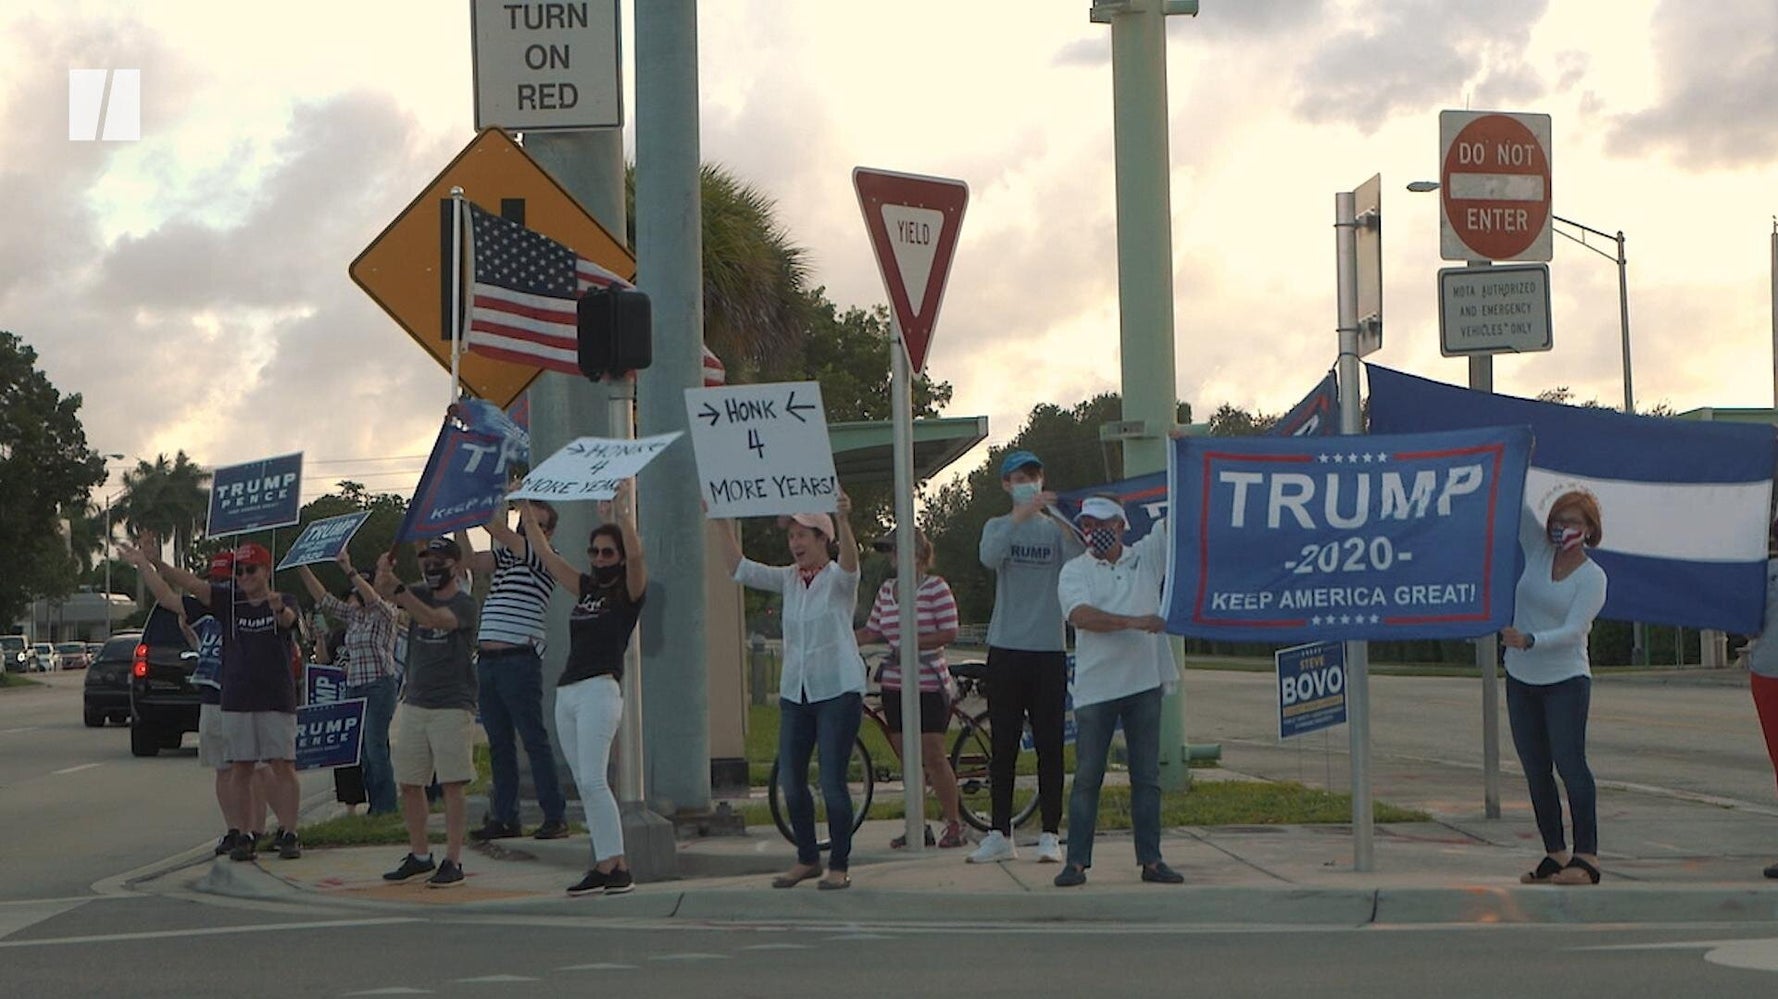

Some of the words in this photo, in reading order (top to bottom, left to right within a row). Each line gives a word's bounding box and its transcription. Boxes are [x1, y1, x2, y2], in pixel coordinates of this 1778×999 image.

[503, 2, 588, 30] TURN
[525, 44, 570, 70] ON
[517, 83, 578, 110] RED
[1459, 142, 1485, 165] DO
[1497, 143, 1535, 166] NOT
[1467, 208, 1528, 231] ENTER
[897, 220, 930, 245] YIELD
[1482, 281, 1536, 298] AUTHORIZED
[1460, 305, 1478, 317] AND
[1482, 302, 1532, 317] EMERGENCY
[1460, 324, 1503, 337] VEHICLES
[1510, 323, 1532, 335] ONLY
[724, 398, 777, 423] HONK
[748, 428, 764, 459] 4
[217, 473, 297, 499] TRUMP
[709, 478, 768, 504] MORE
[772, 475, 838, 498] YEARS!
[1218, 463, 1484, 530] TRUMP
[221, 489, 288, 509] PENCE
[1010, 544, 1051, 559] RUMP
[1211, 591, 1274, 611] KEEP
[1279, 586, 1388, 611] AMERICA
[1394, 582, 1476, 605] GREAT!
[1299, 654, 1324, 670] STEVE
[1281, 665, 1343, 706] BOVO
[295, 717, 357, 737] RUMP
[298, 732, 349, 748] ENCE
